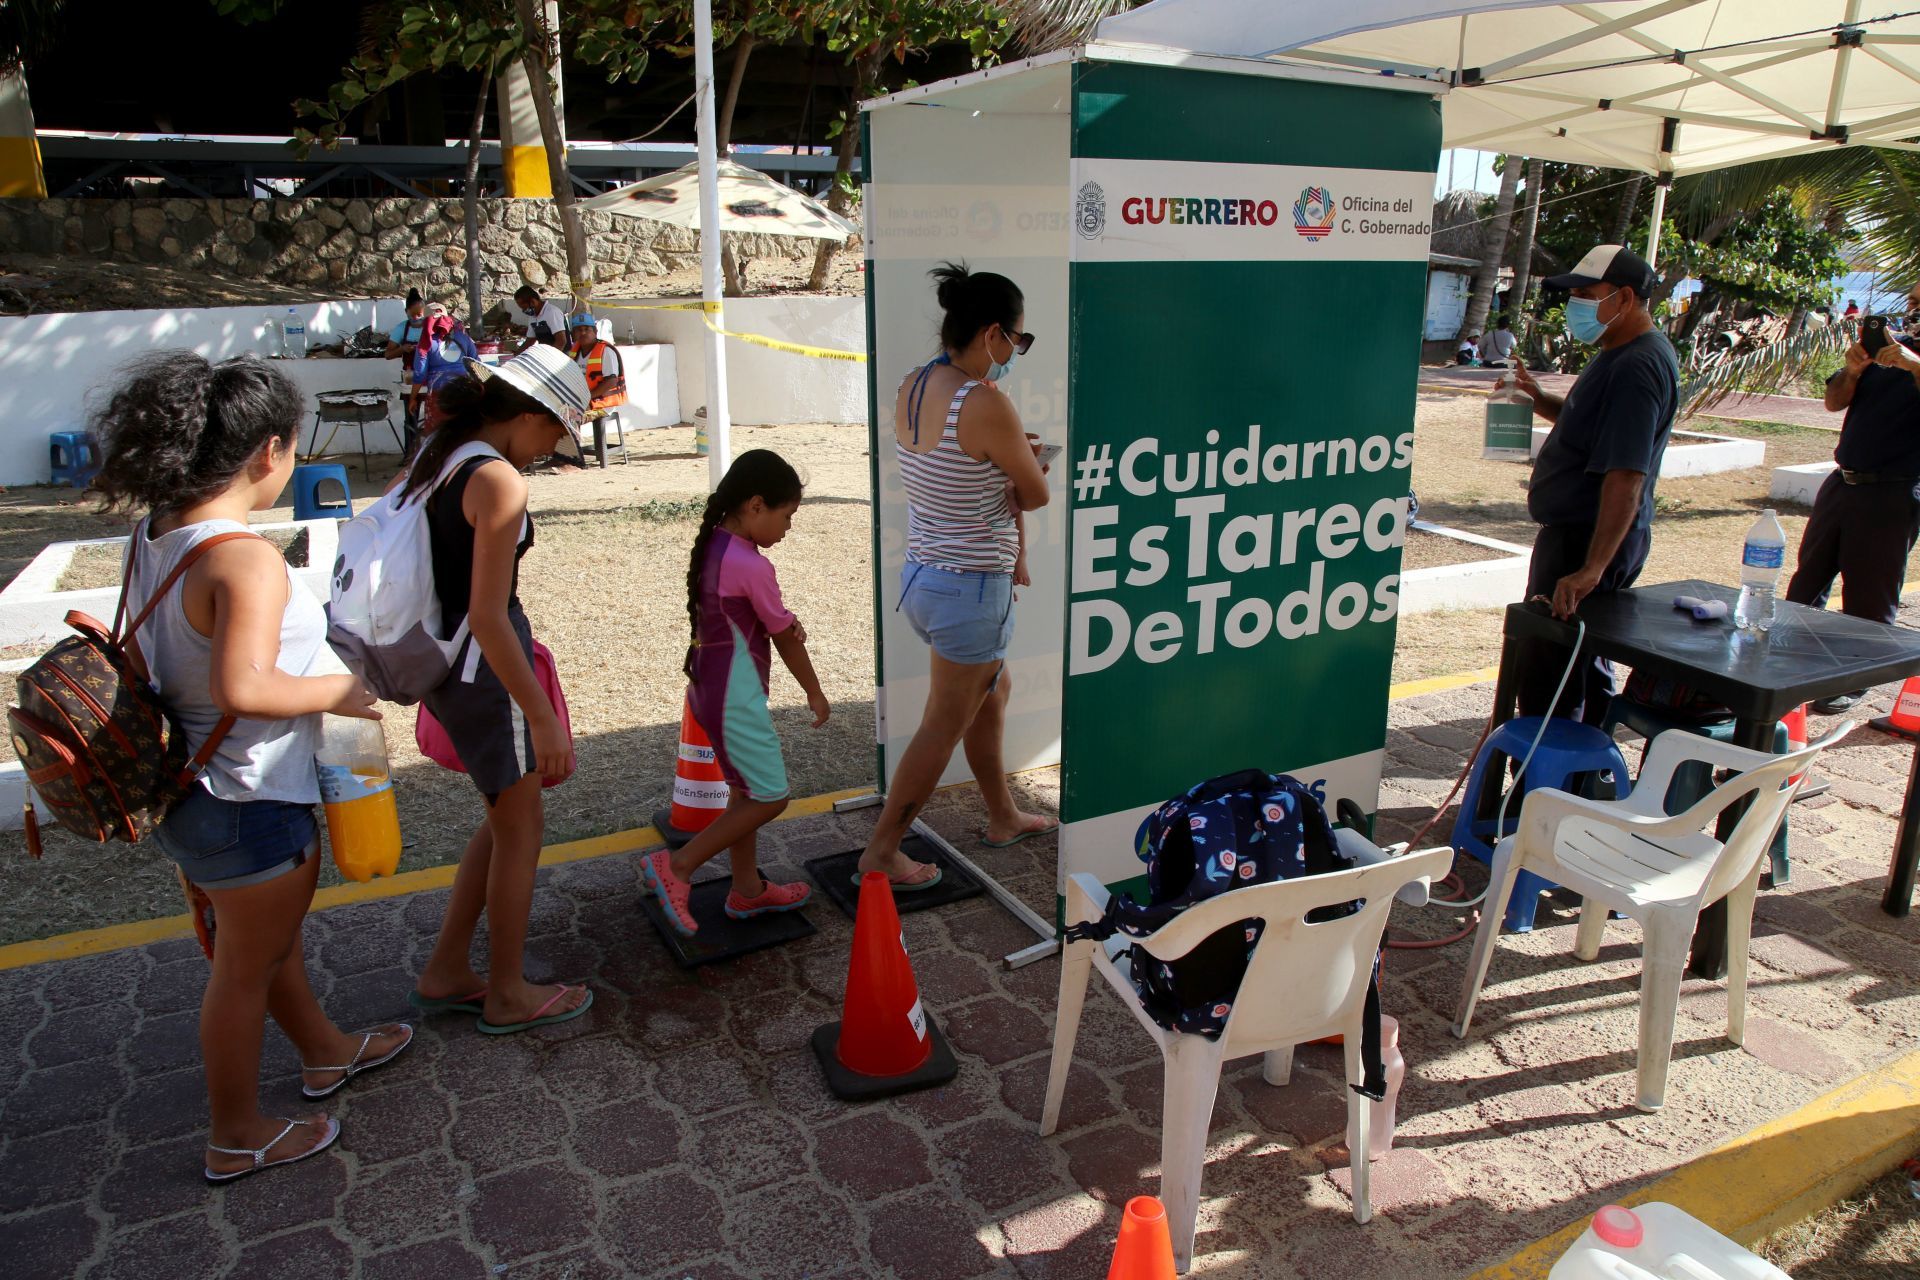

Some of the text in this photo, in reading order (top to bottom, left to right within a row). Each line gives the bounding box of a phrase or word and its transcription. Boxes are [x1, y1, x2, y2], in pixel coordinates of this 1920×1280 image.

[1121, 197, 1278, 226] GUERRERO
[1342, 196, 1413, 213] Oficina del
[1341, 219, 1431, 236] C. Gobernado
[1073, 424, 1414, 501] #Cuidarnos
